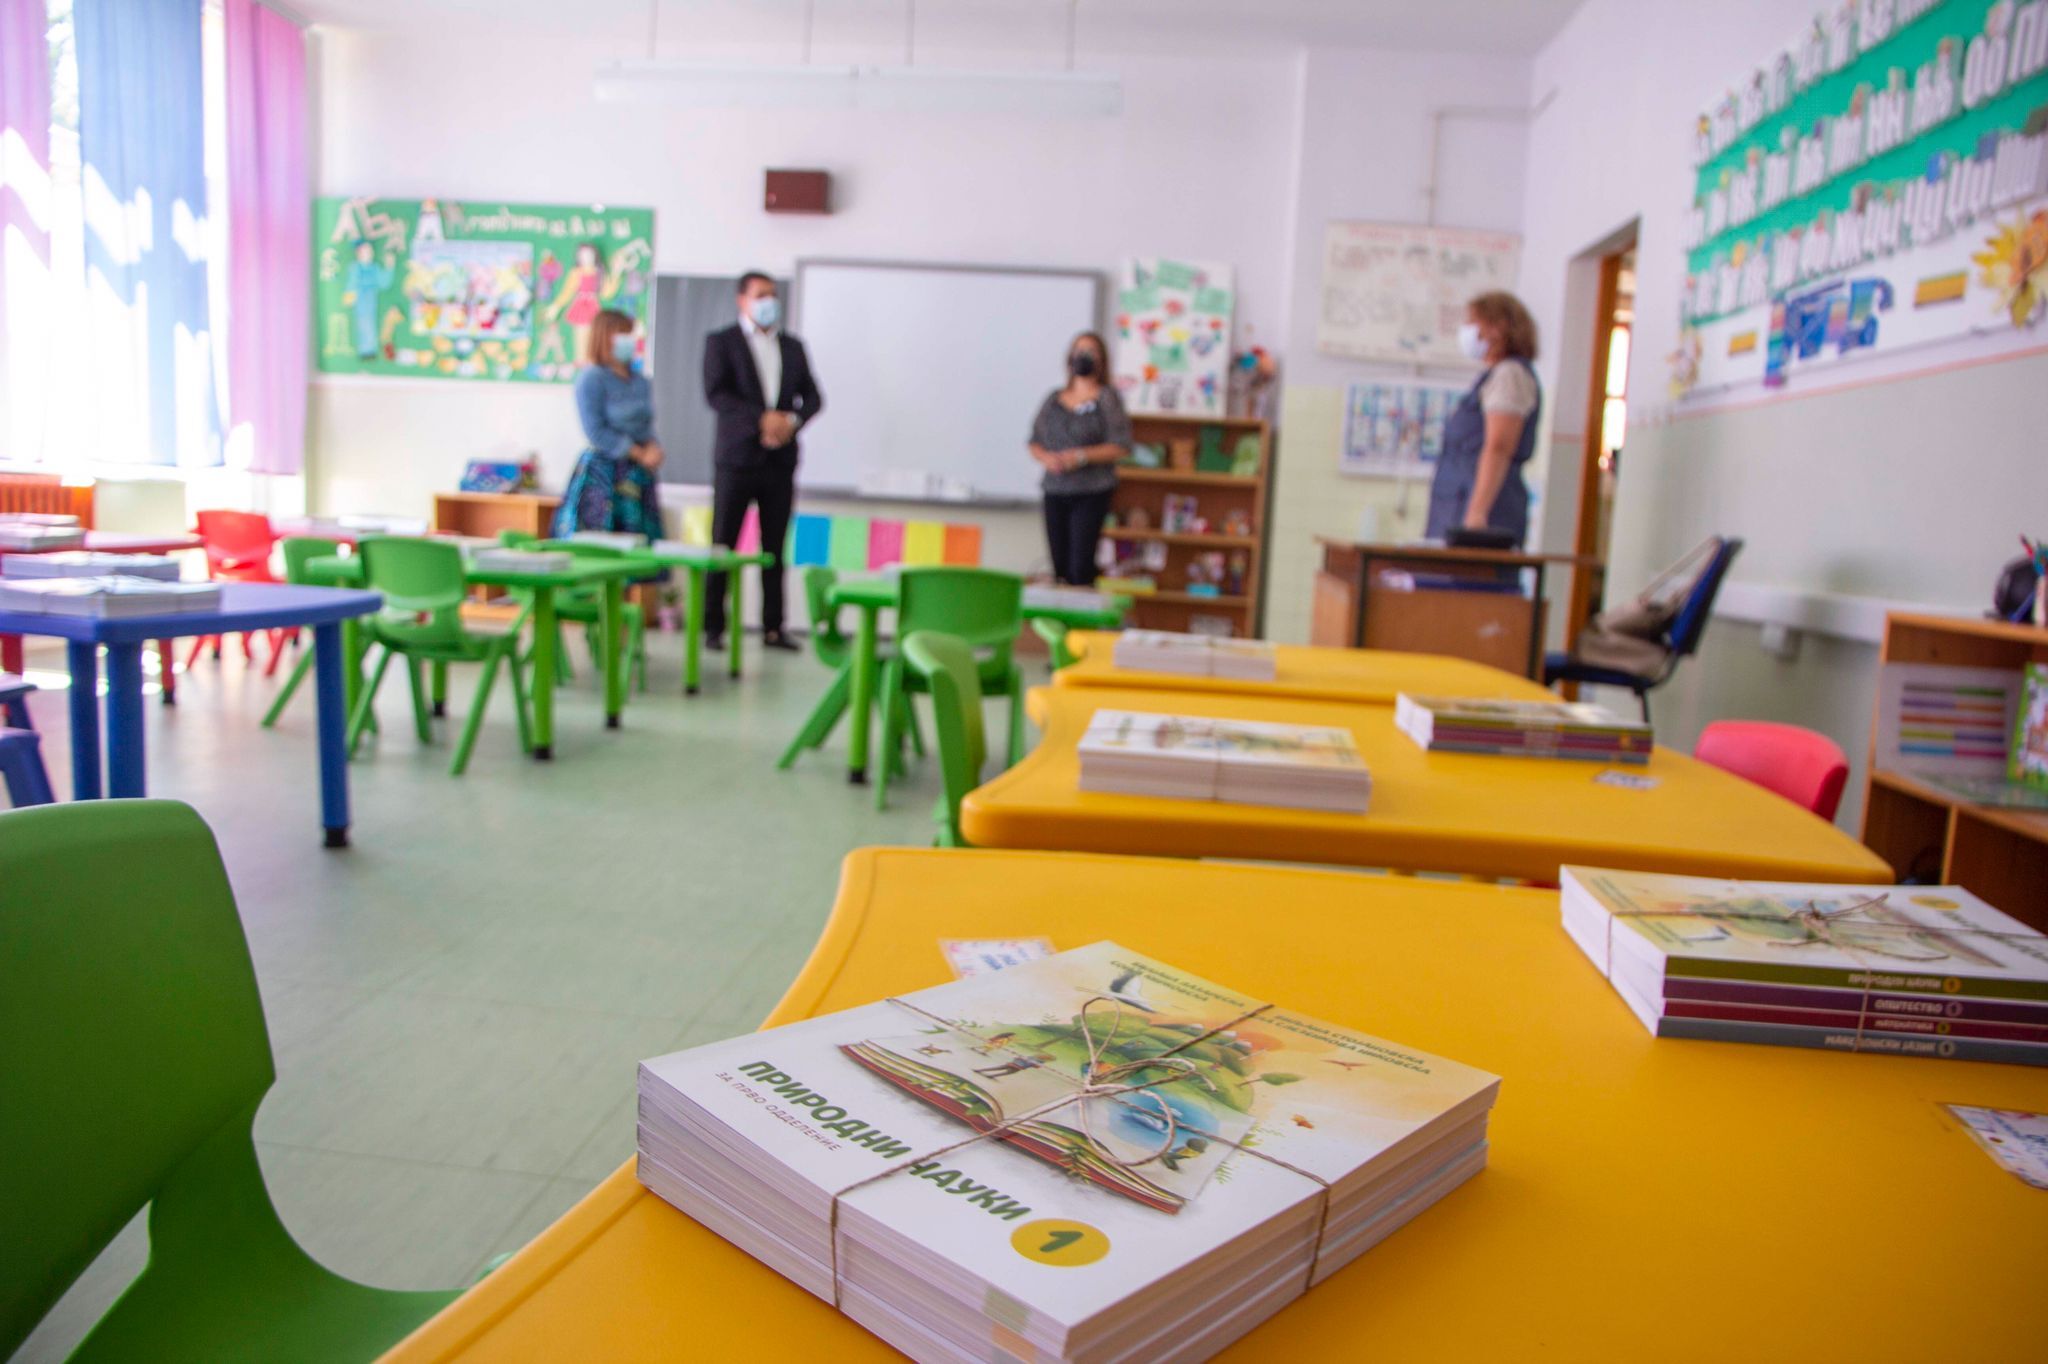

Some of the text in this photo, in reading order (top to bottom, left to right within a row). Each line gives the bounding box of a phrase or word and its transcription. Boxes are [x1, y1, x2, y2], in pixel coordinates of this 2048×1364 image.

[715, 1071, 843, 1151] ЗА ПРВО ОДДЕЛЕНИЕ
[738, 1060, 1085, 1253] ПРИРОДНИ НАУКИ 1
